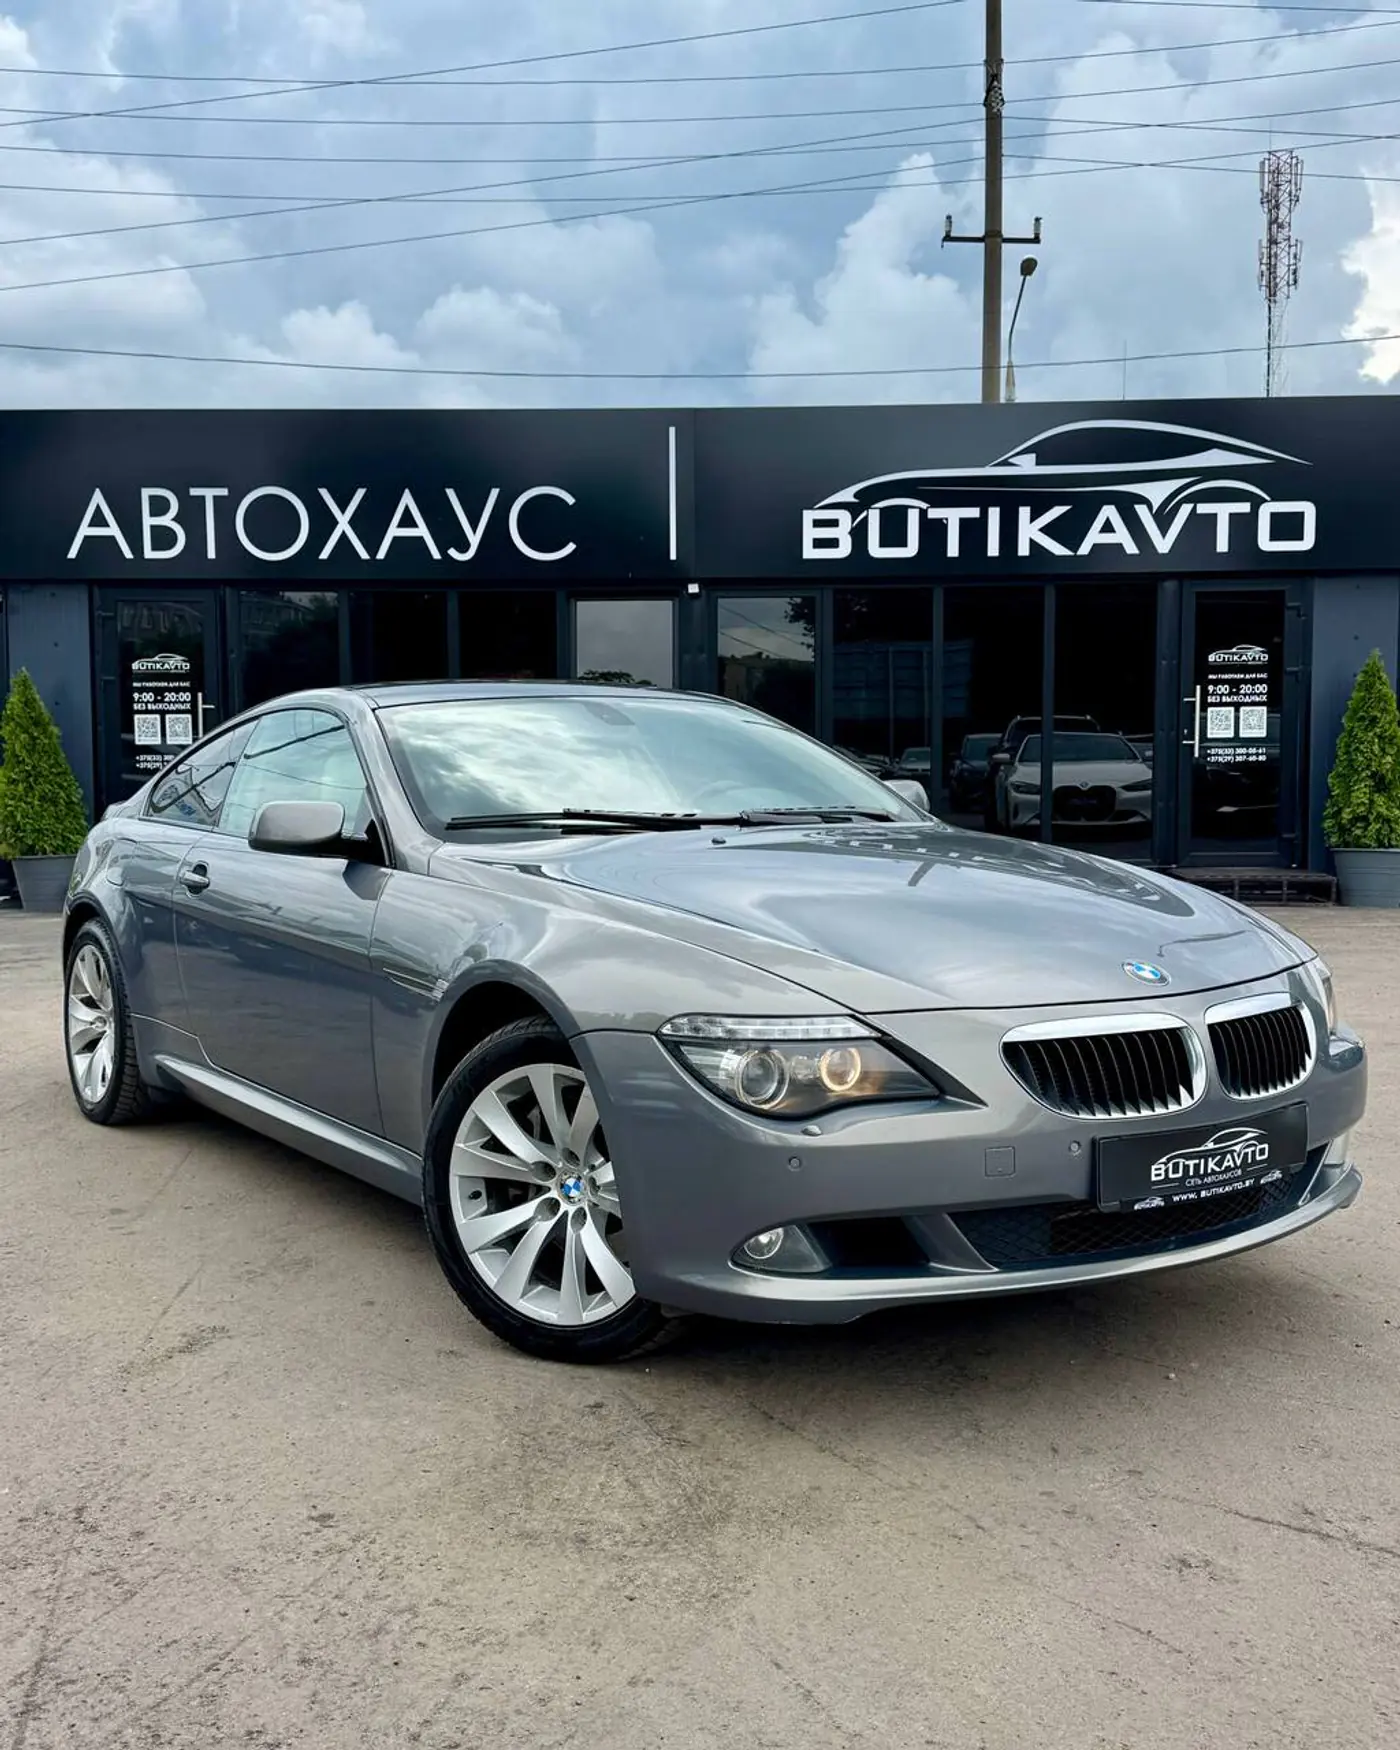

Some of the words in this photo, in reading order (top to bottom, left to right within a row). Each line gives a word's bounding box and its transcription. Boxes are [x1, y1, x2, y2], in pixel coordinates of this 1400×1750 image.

[66, 485, 578, 561] АВТОХАУС
[801, 500, 1317, 559] BUTIKAVTO
[1208, 654, 1269, 662] BUTIKAVTO
[1207, 684, 1230, 694] 9:00
[1239, 683, 1268, 694] 20:00
[132, 692, 155, 702] 9:00
[164, 692, 191, 702] 20:00
[1207, 695, 1220, 703] БЕЗ
[1222, 695, 1267, 703] ВЫХОДНЫХ
[1151, 1144, 1269, 1181] BUTIKAVTO
